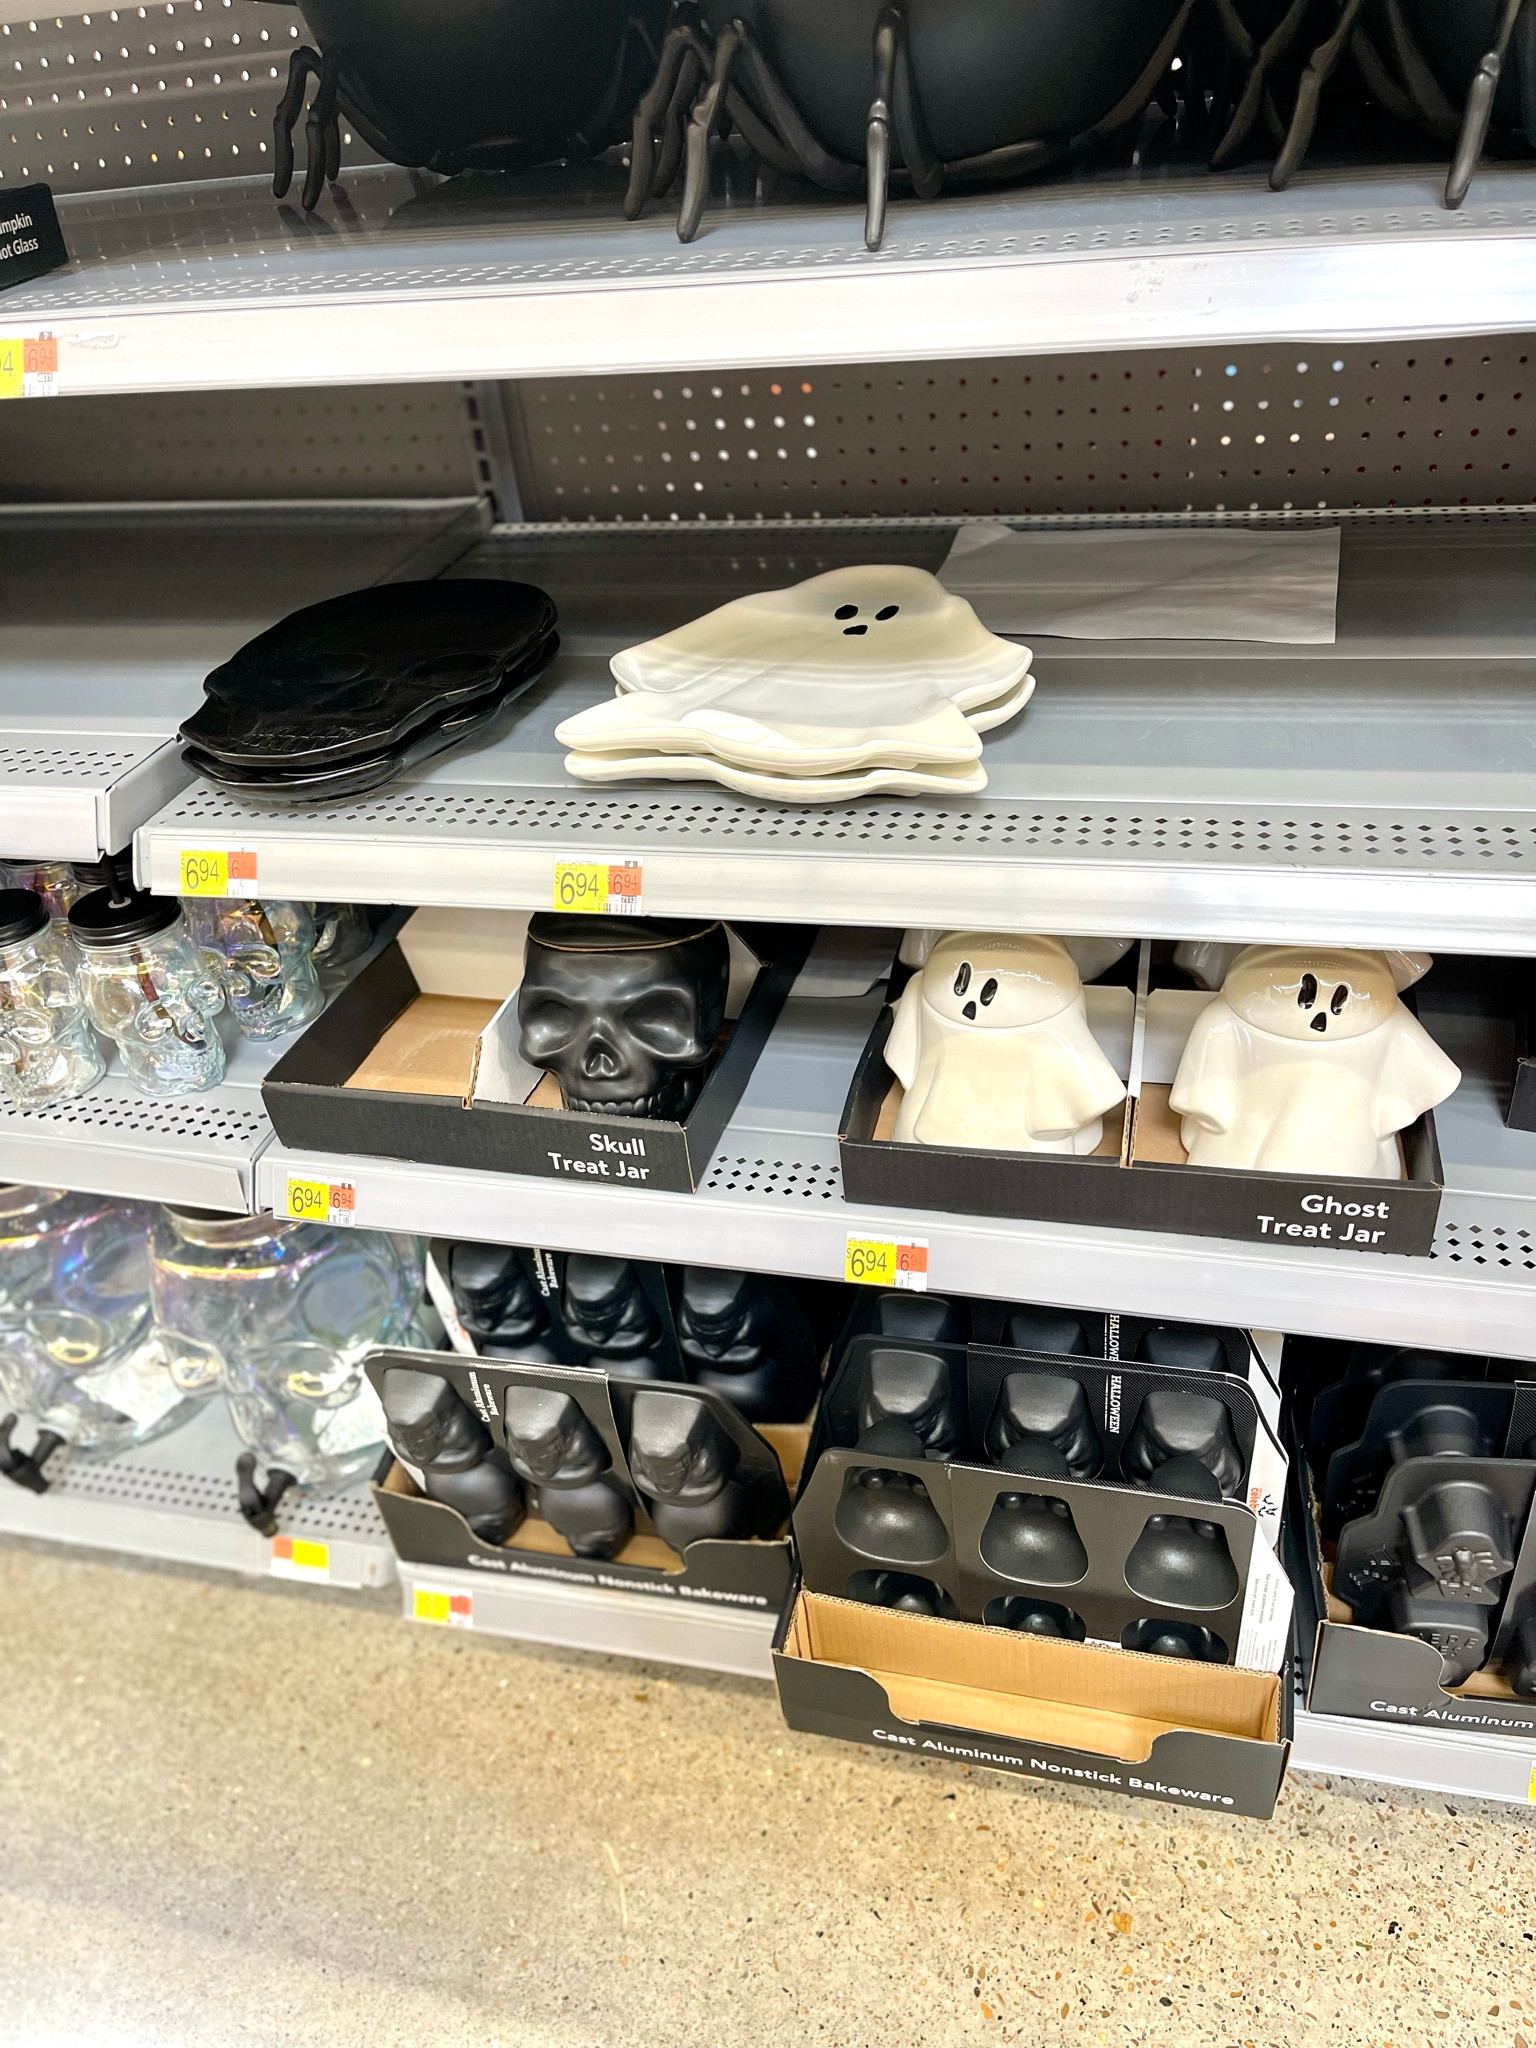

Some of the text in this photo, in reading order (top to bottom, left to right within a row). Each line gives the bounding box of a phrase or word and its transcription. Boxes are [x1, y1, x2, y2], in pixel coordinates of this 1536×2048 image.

[13, 238, 39, 255] Glass
[589, 1133, 646, 1156] Skull
[547, 1152, 650, 1180] Treat Jar
[1301, 1194, 1390, 1219] Ghost
[1257, 1215, 1386, 1244] Treat Jar
[533, 1247, 551, 1297] Cast Aluminu
[545, 1253, 559, 1289] Bakeware
[483, 1383, 500, 1416] Bakeware
[1109, 1375, 1122, 1434] HALLOWEEN
[479, 1408, 491, 1423] Cast
[467, 1553, 768, 1607] Cast Aluminum Nonstick Bakeware
[1370, 1700, 1534, 1729] Cast Aluminum
[872, 1728, 1235, 1806] Cast Aluminum Nonstick Bakeware
